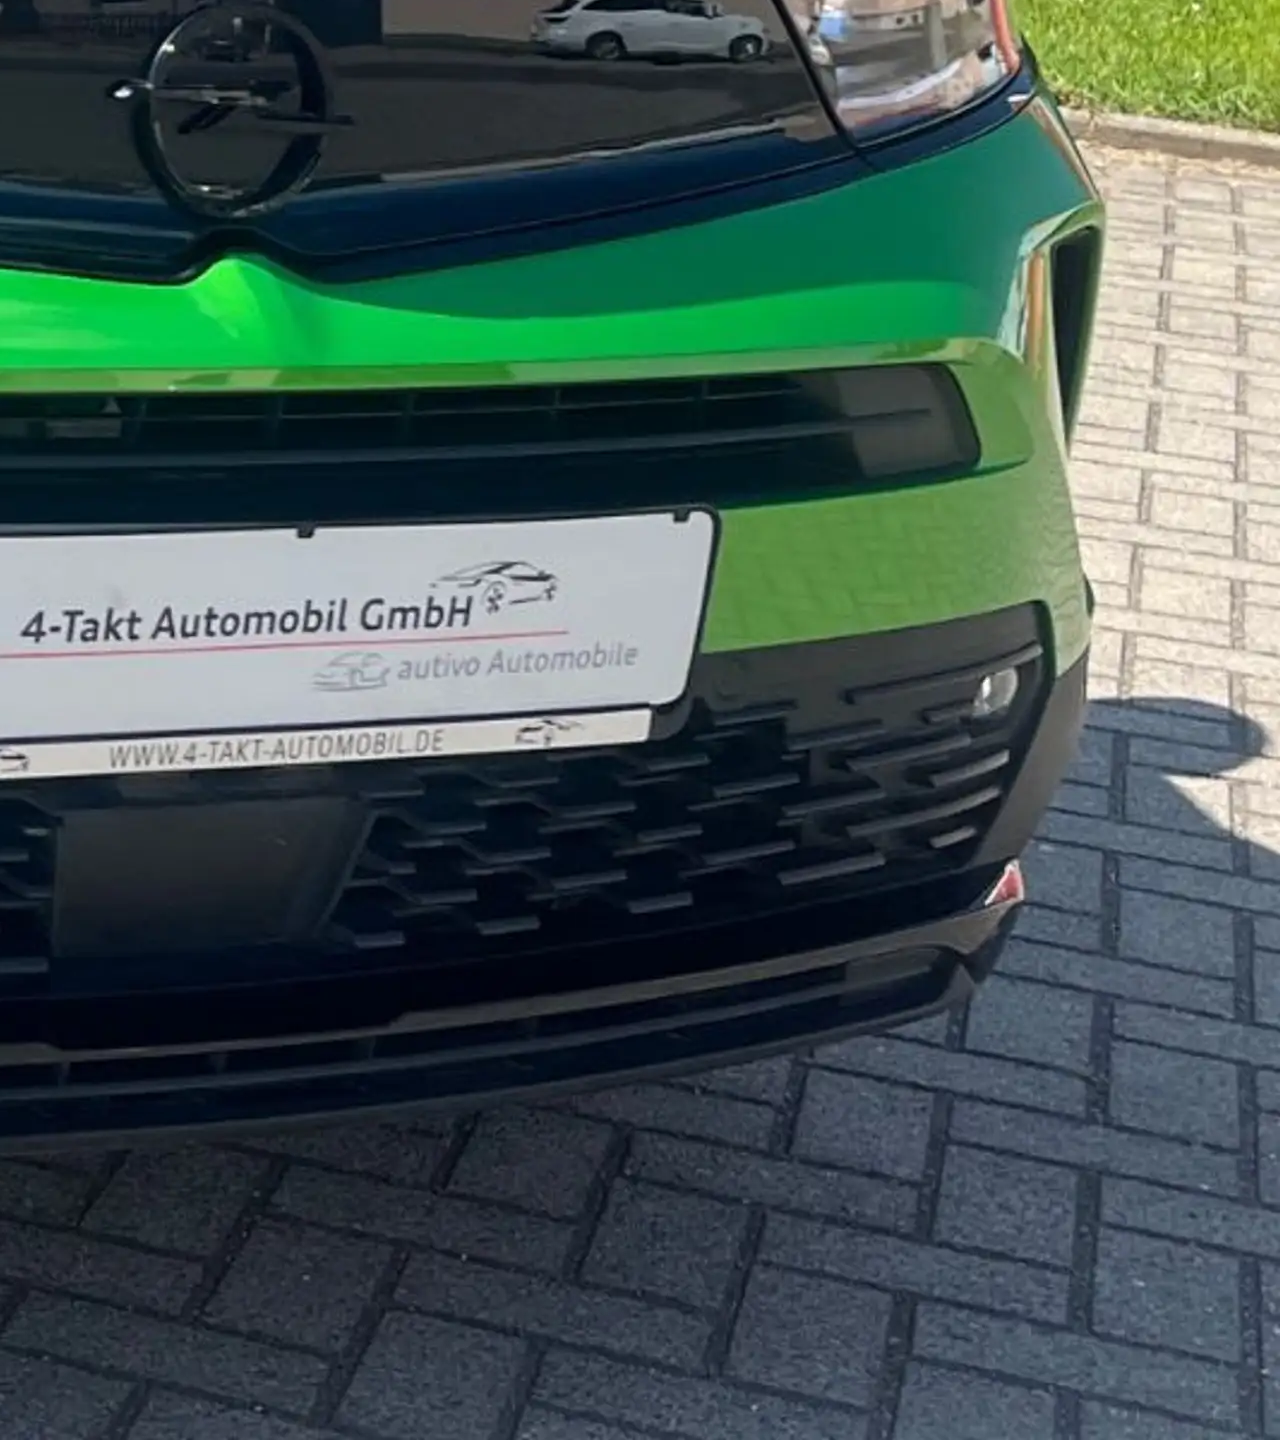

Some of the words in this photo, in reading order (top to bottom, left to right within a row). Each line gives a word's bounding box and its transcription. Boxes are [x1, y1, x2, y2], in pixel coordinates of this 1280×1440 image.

[19, 606, 142, 643] 4-Takt
[150, 599, 348, 640] Automobil
[360, 595, 473, 631] GmbH
[397, 653, 481, 681] autivo
[487, 642, 639, 675] Automobile
[109, 729, 445, 769] WWW.4-TAKT-AUTOMOBIL.DE
